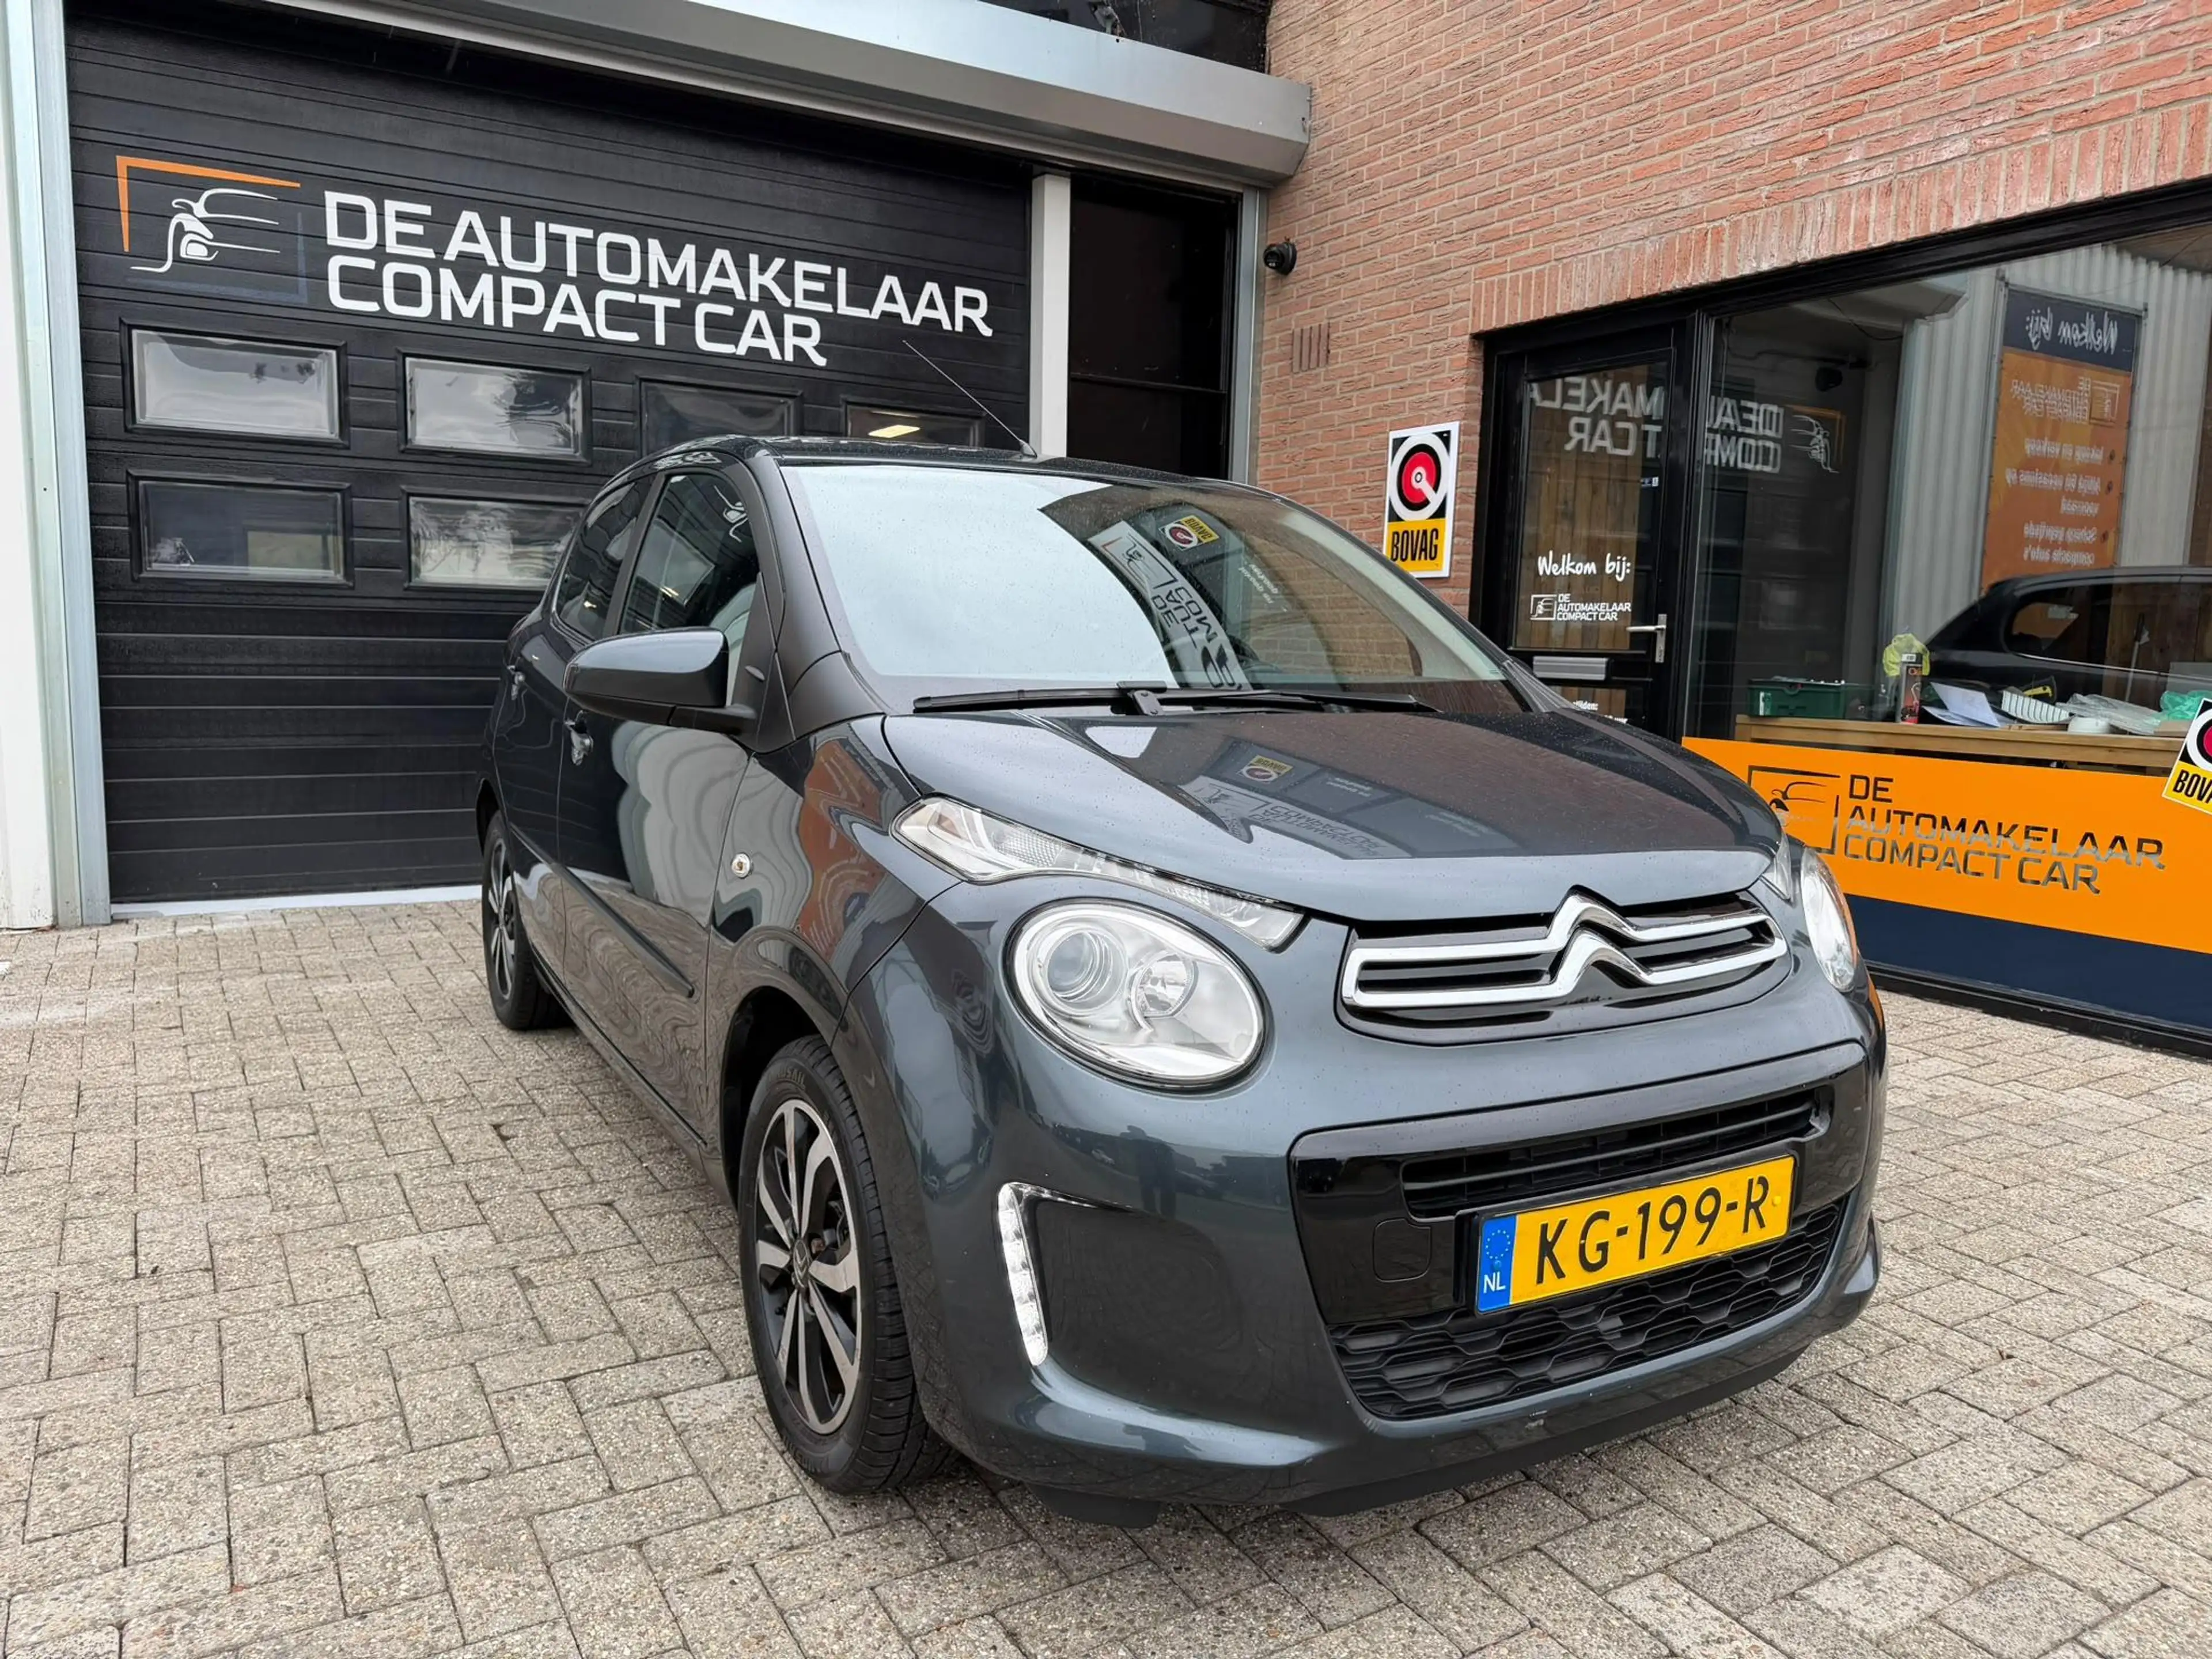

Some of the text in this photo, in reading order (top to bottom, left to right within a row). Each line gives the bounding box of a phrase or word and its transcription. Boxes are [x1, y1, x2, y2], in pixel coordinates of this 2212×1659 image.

[324, 190, 993, 337] DE AUTOMAKELAAR
[327, 255, 827, 366] COMPACT CAR
[1391, 528, 1439, 562] BOVAG
[1537, 550, 1631, 582] Welkom bij:
[1557, 603, 1632, 612] AUTOMAKELAAR
[1558, 593, 1571, 603] DE
[1556, 612, 1618, 622] COMPACT CAR
[1849, 774, 1894, 804] DE
[1844, 805, 2166, 871] AUTOMAKELAAR
[1844, 834, 2101, 896] COMPACT CAR
[1536, 1174, 1770, 1285] KG-199-R
[1483, 1271, 1506, 1294] NL
